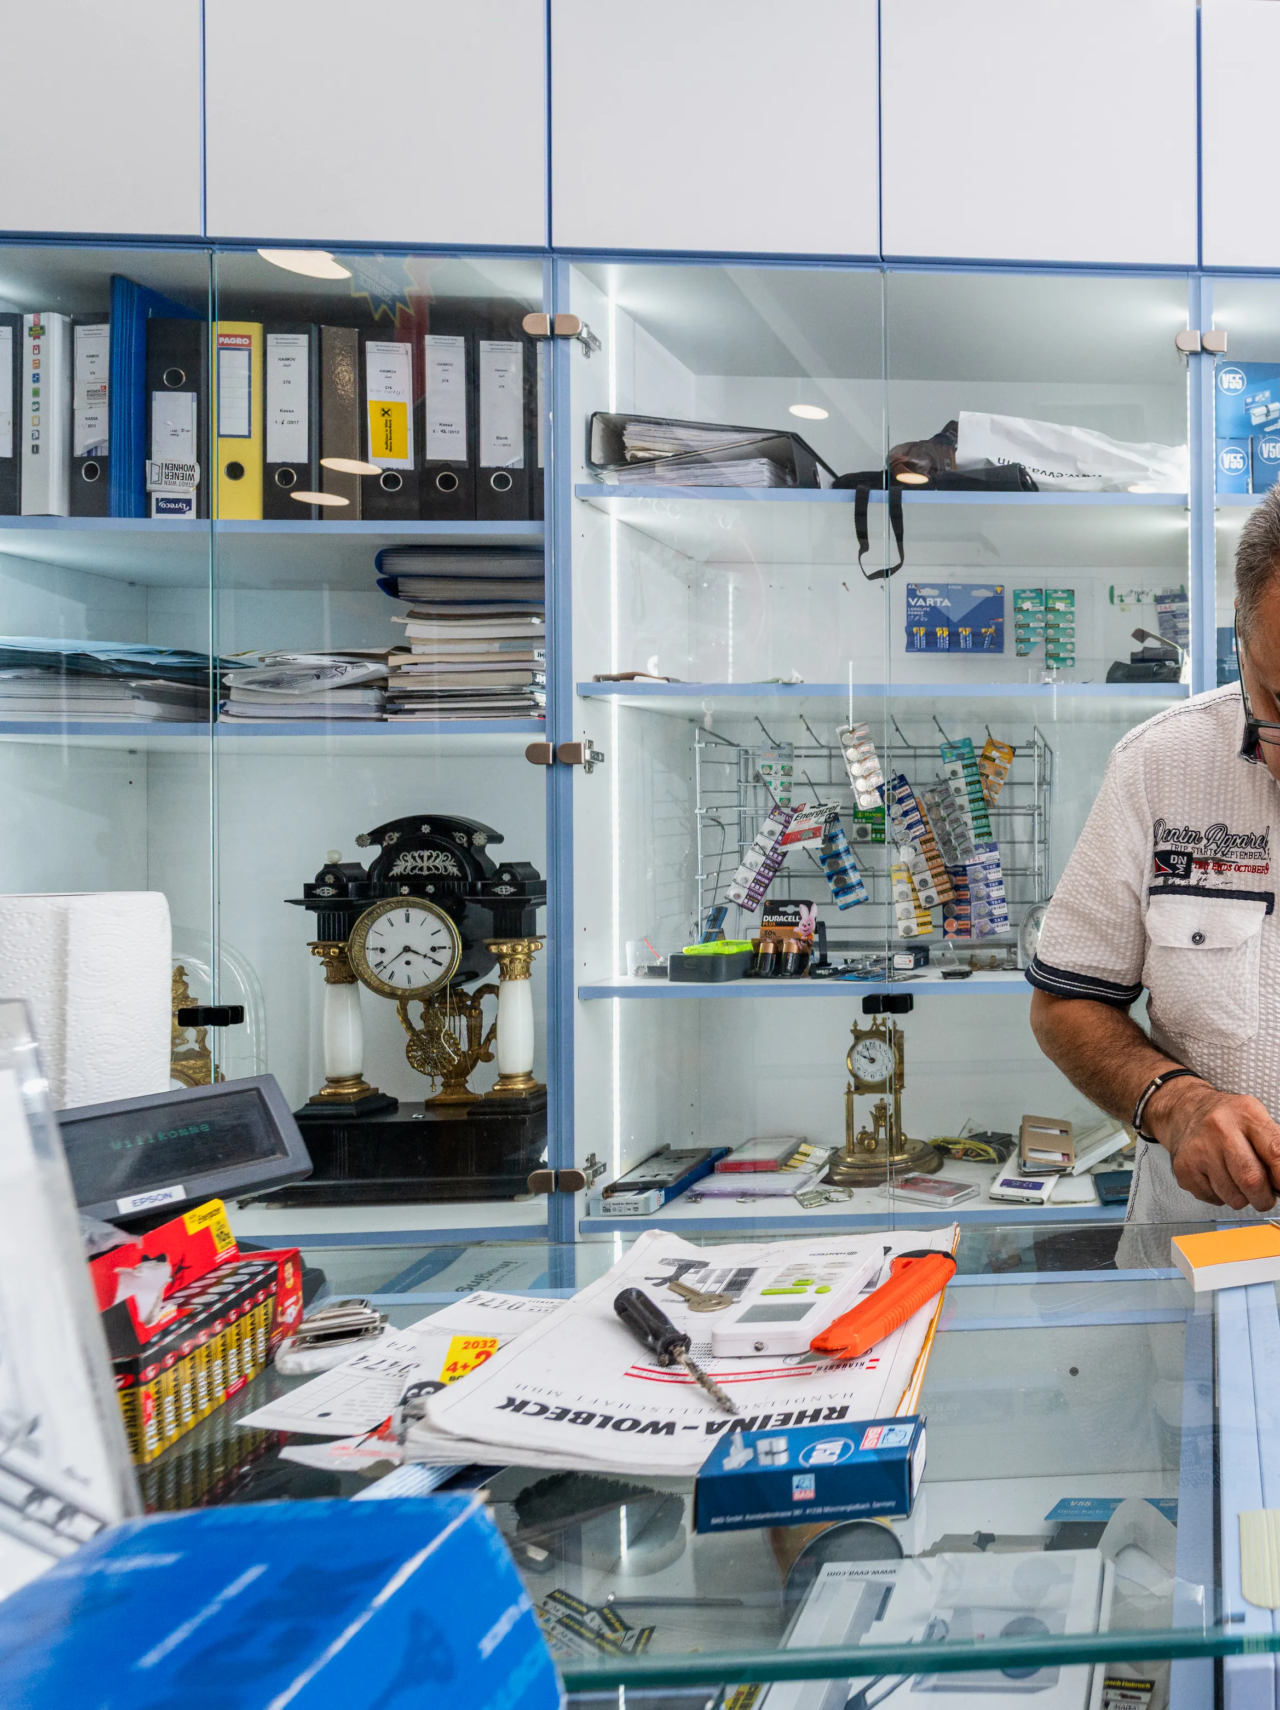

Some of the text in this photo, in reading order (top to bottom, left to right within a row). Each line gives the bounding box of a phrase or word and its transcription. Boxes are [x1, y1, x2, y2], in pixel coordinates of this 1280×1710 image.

[219, 336, 250, 345] PAGRO
[1222, 373, 1243, 390] V55
[164, 463, 196, 473] WOHNEN
[1222, 453, 1244, 470] V55
[164, 471, 195, 482] WIENER
[908, 597, 951, 607] VARTA
[793, 803, 840, 821] Energizer
[1153, 818, 1271, 855] Denim Apparel
[1170, 843, 1188, 852] TRIP
[763, 914, 800, 922] DURACELL
[131, 1191, 173, 1208] EPSON
[256, 1328, 266, 1363] GOLD
[462, 1339, 497, 1350] 2032
[243, 1338, 253, 1374] GOLD
[446, 1350, 493, 1374] 4+2
[228, 1348, 239, 1385] GOLD
[213, 1360, 224, 1397] GOLD
[198, 1371, 208, 1410] GOLD
[181, 1383, 193, 1423] GOLD
[164, 1395, 176, 1437] GOLD
[826, 1568, 896, 1578] www.evva.com
